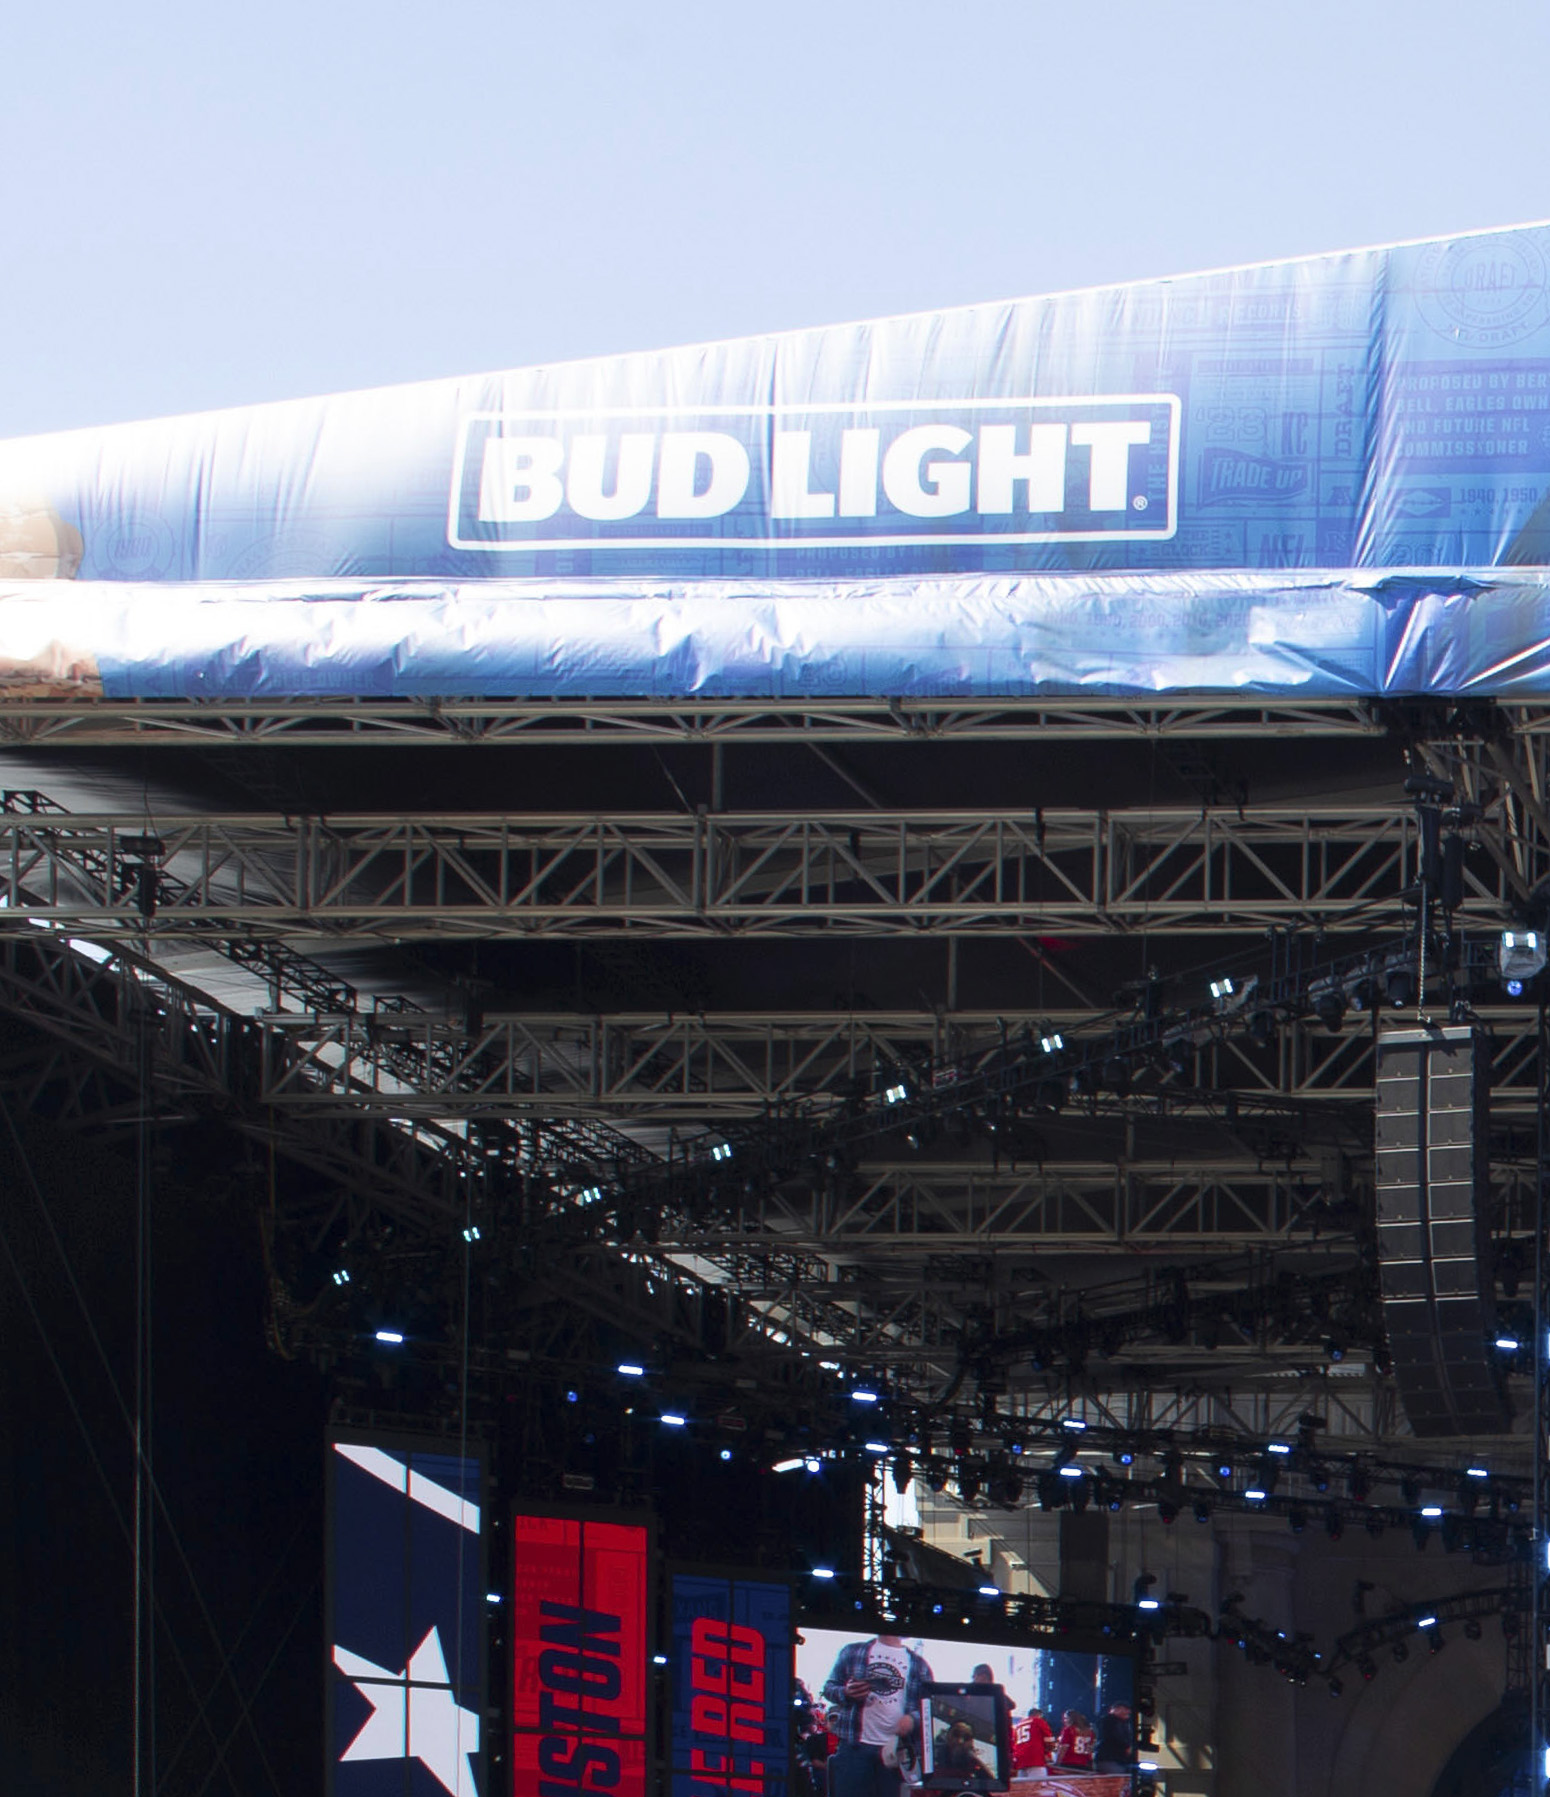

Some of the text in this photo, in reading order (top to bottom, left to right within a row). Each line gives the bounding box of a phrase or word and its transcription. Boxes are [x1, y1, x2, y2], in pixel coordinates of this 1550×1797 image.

[1489, 374, 1510, 389] BY
[1446, 396, 1505, 411] EAGLES
[479, 421, 1150, 522] BUD LIGHT
[1210, 457, 1303, 490] TRADE UP
[691, 1616, 765, 1745] RED
[1017, 1725, 1031, 1744] 15
